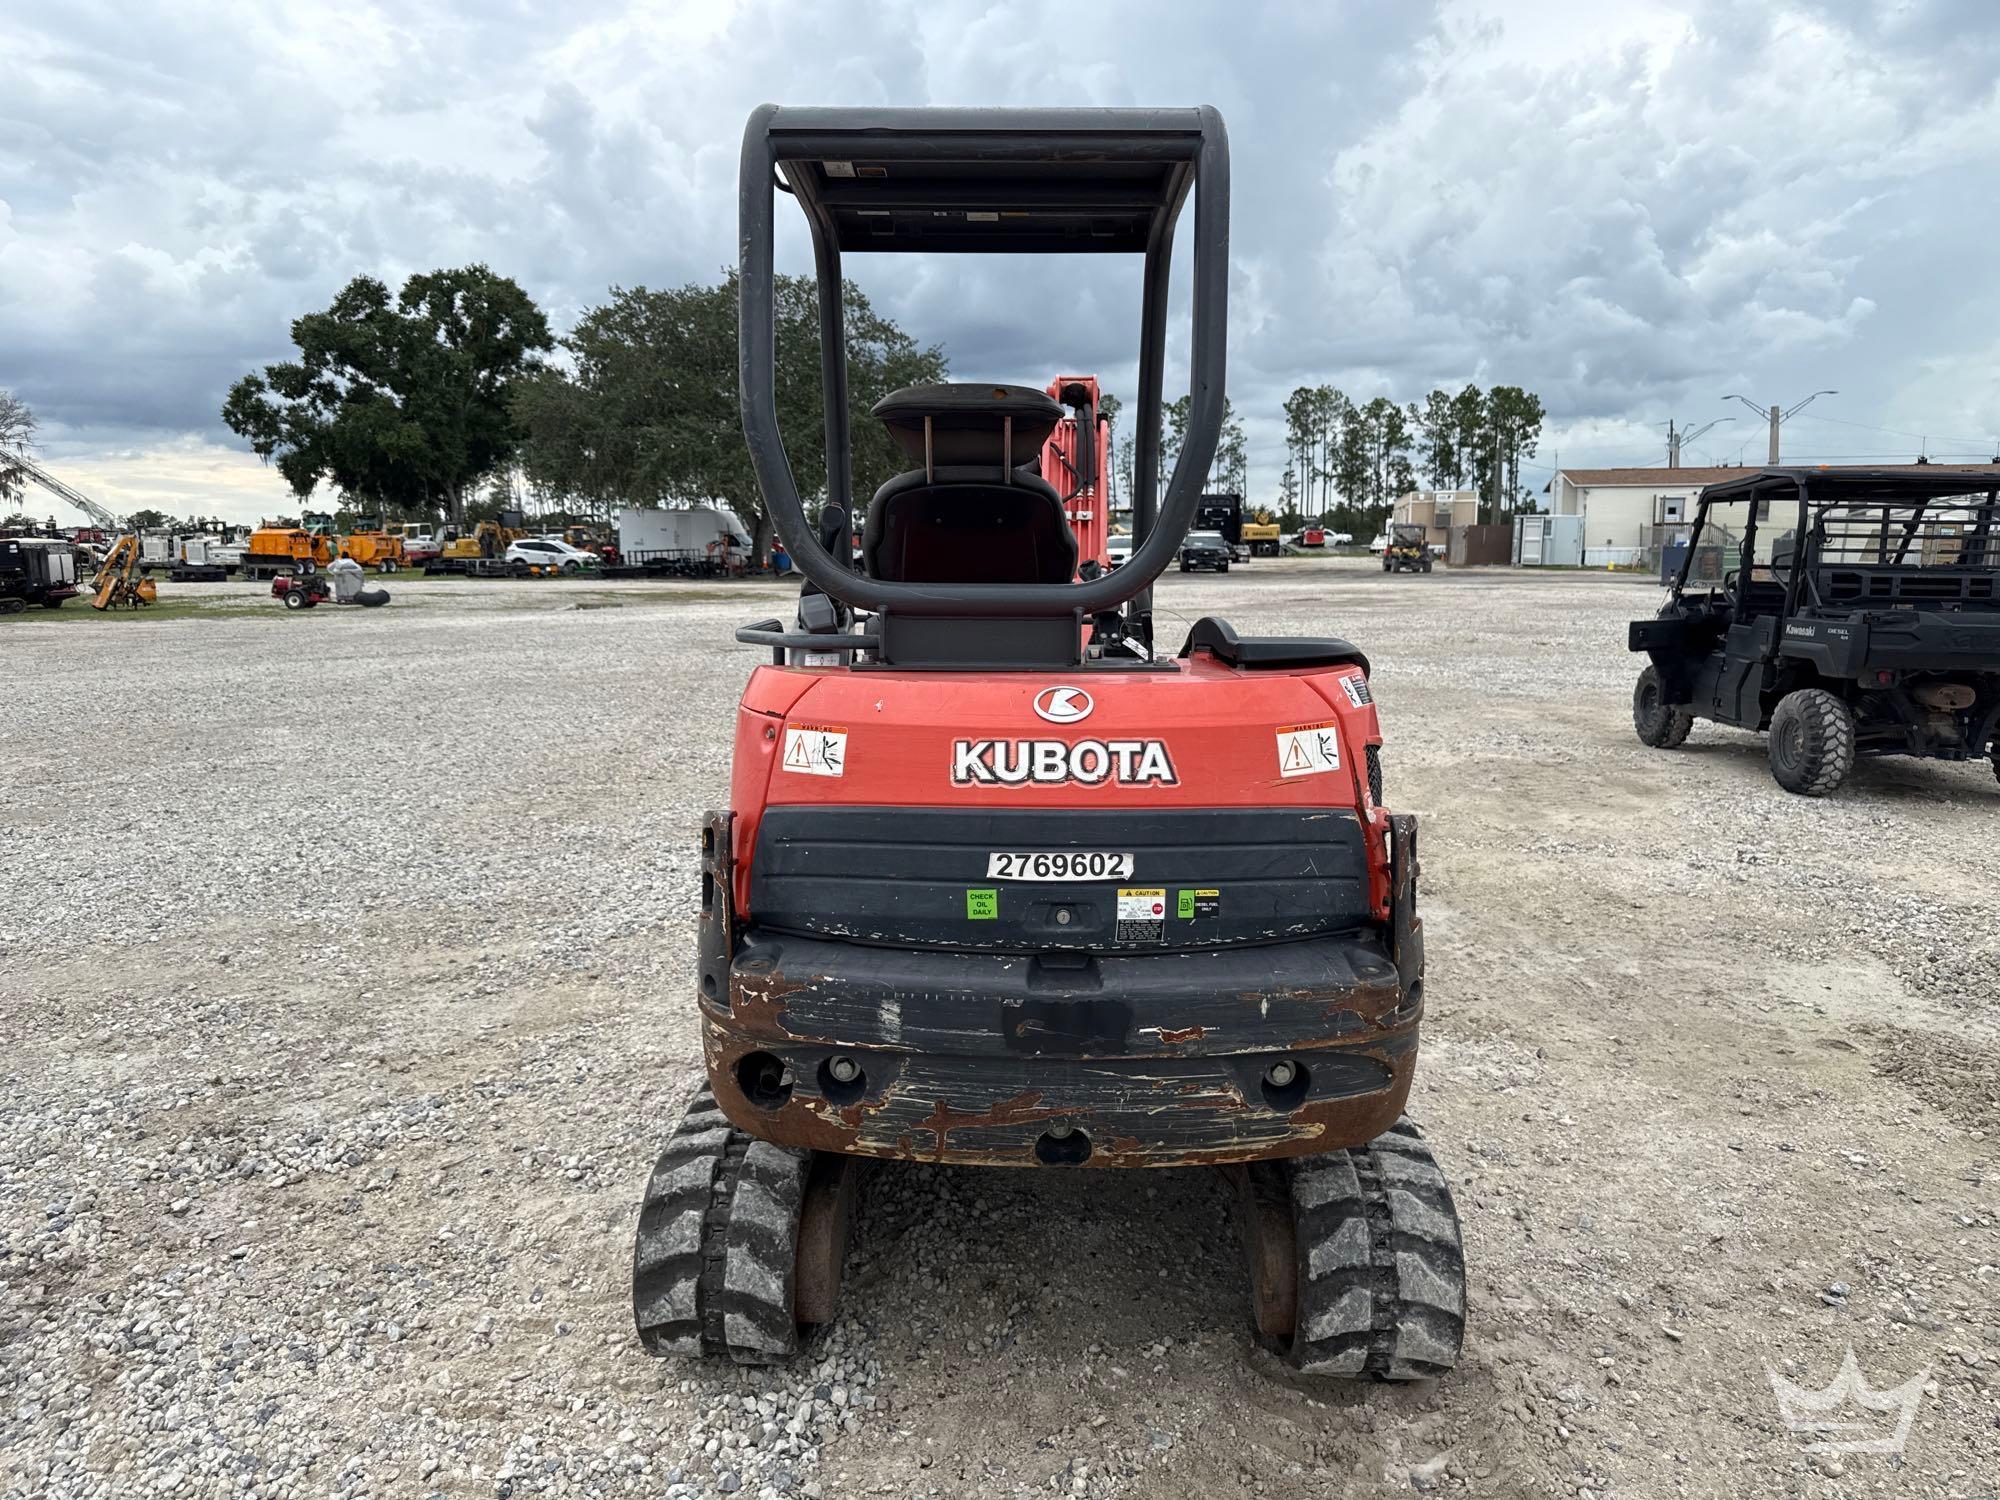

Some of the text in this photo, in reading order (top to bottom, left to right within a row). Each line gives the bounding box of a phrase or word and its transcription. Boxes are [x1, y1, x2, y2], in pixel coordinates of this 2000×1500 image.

[1785, 624, 1816, 637] Kawasaki
[1294, 723, 1325, 732] WARNING
[953, 739, 1178, 784] KUBOTA
[996, 853, 1125, 877] 2769602
